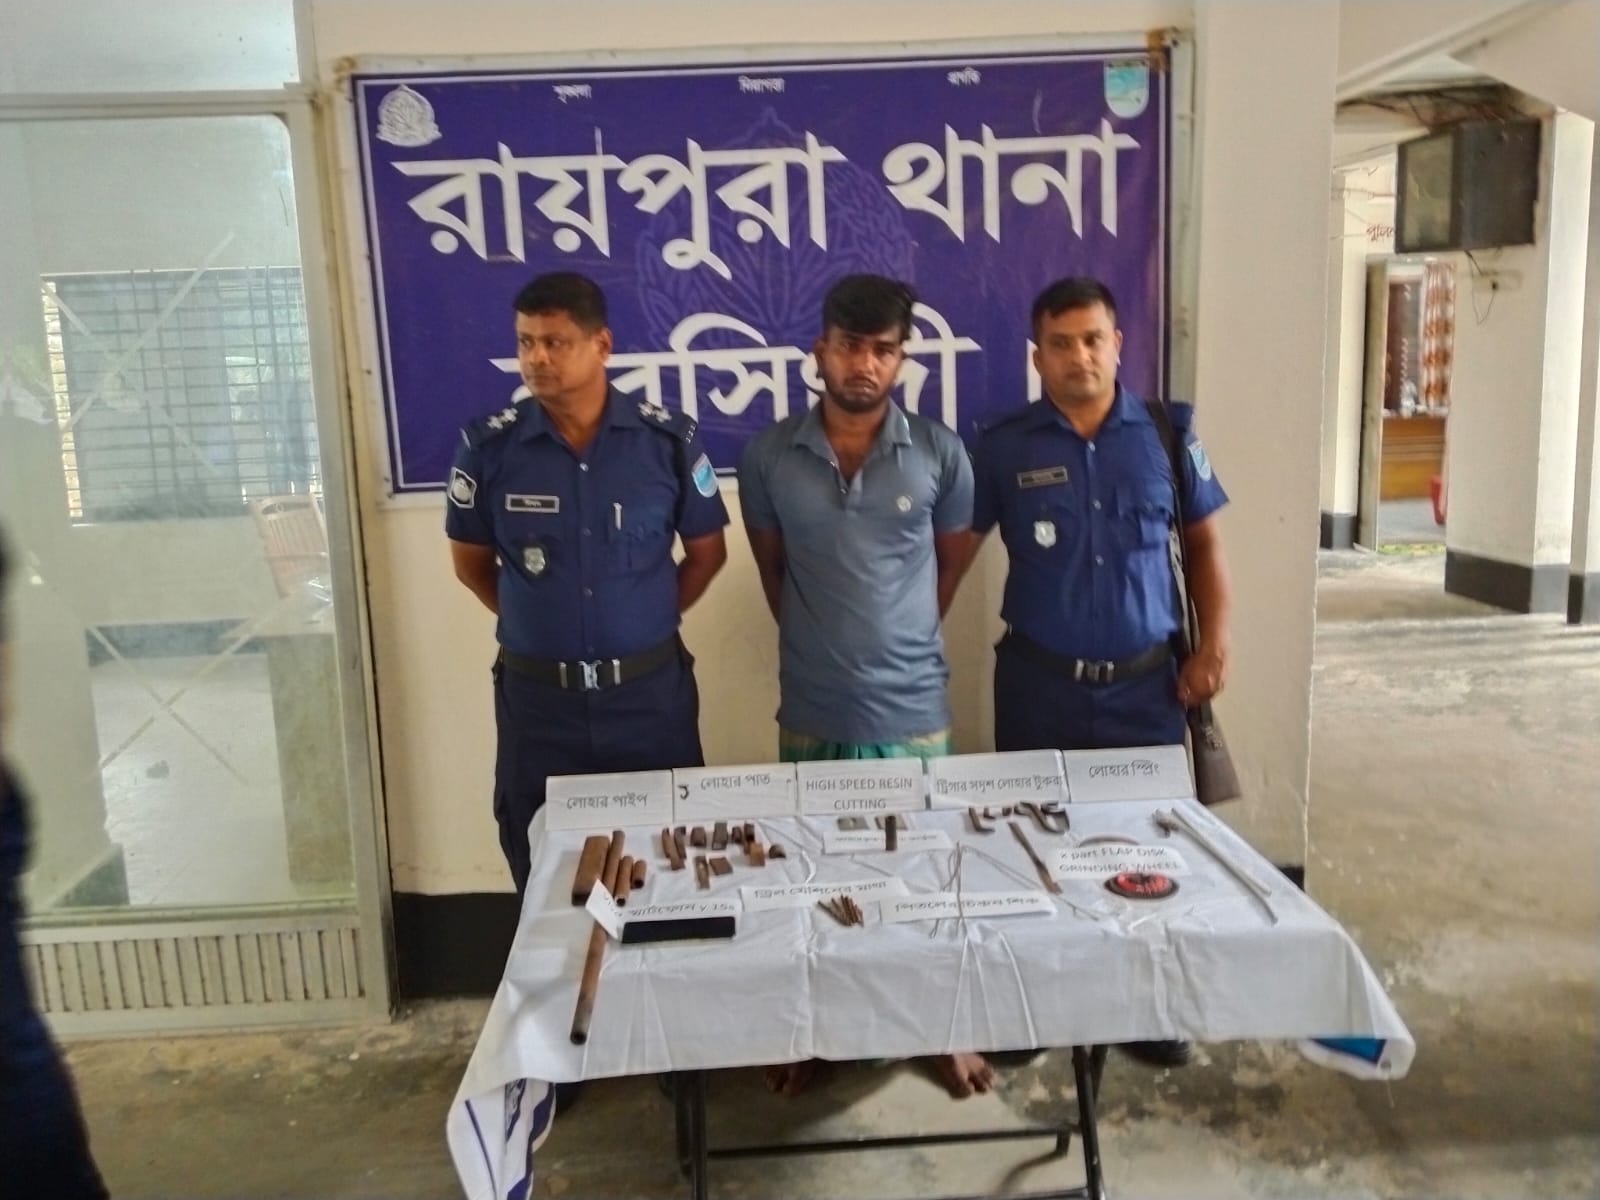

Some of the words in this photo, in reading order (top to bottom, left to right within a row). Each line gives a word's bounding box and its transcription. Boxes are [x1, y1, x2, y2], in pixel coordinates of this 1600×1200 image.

[390, 129, 848, 280] রায়পুরা
[882, 117, 1141, 243] থানা
[1088, 762, 1129, 779] লোহার
[1130, 759, 1160, 776] স্প্রিং
[700, 775, 742, 790] লোহার
[805, 779, 836, 791] HIGH
[839, 778, 876, 791] SPEED
[879, 777, 913, 789] RESIN
[997, 776, 1032, 790] লোহার
[566, 795, 608, 810] লোহার
[612, 792, 648, 809] পাইপ
[833, 798, 887, 811] CUTTING
